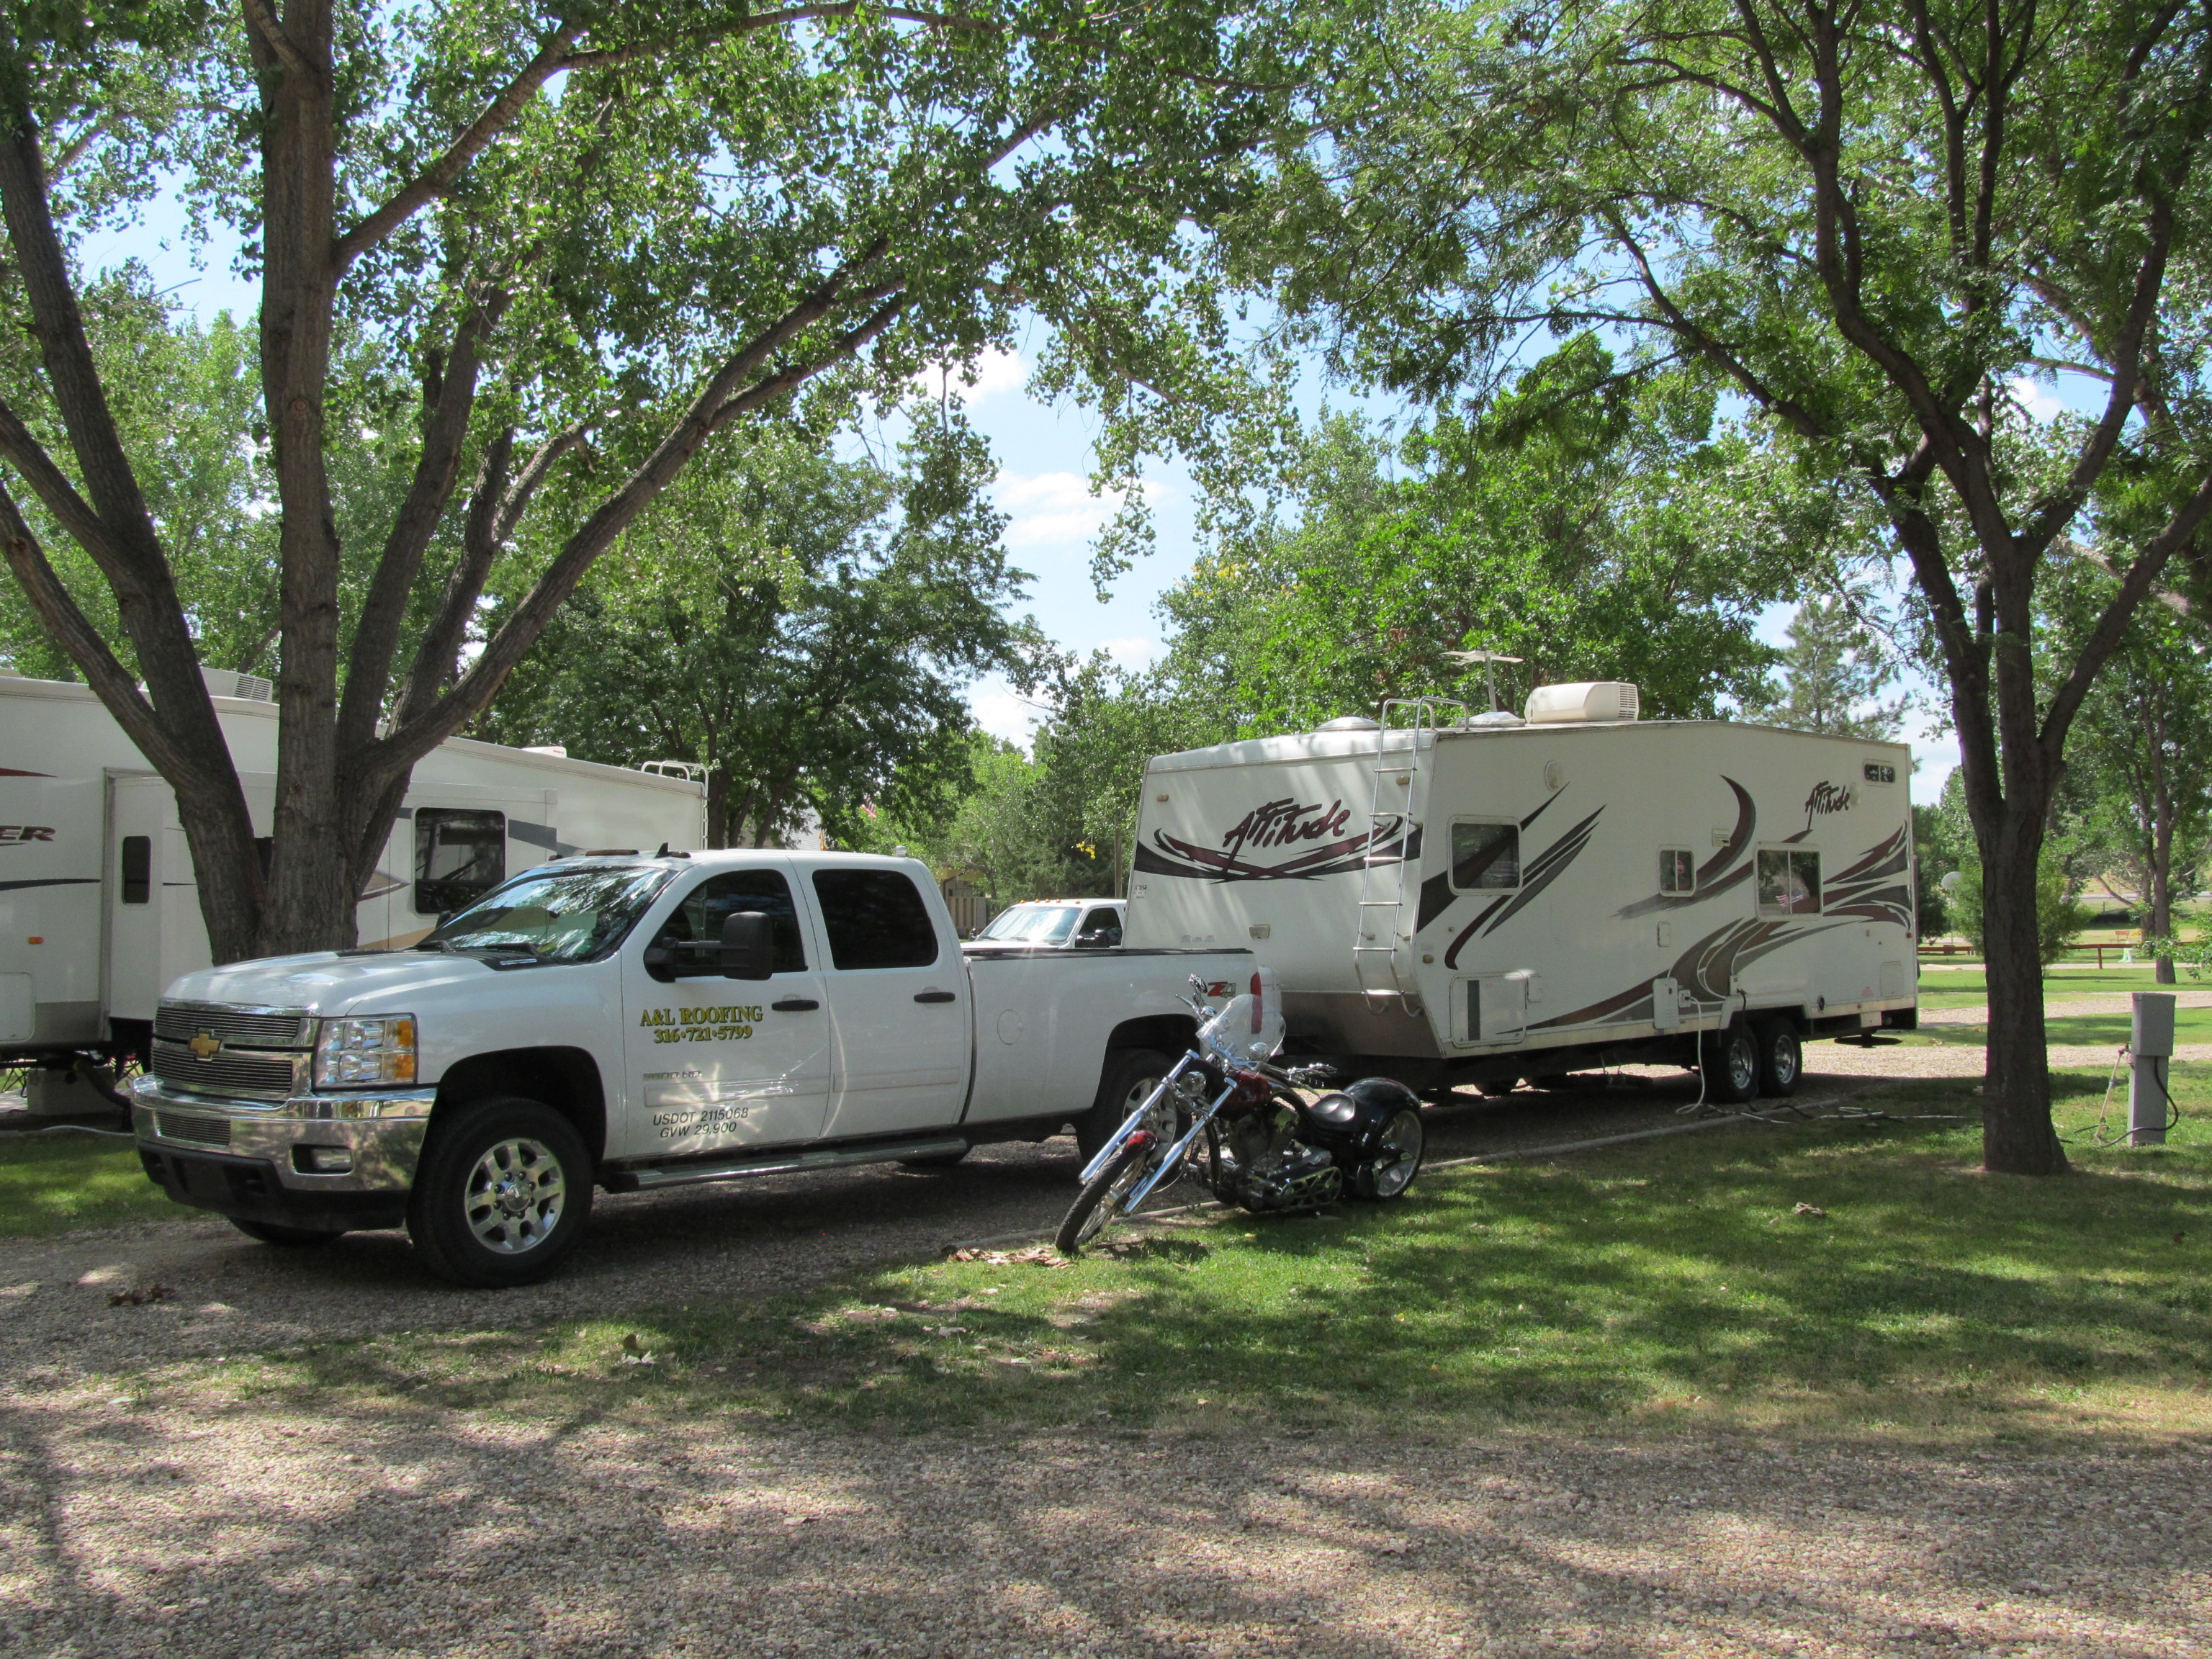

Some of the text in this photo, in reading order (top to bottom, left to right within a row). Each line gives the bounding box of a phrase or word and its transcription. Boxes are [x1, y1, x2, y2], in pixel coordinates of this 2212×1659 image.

[1208, 981, 1236, 997] Z71
[640, 1005, 763, 1027] A&L ROOFING
[653, 1107, 749, 1125] USDOT 2115068
[660, 1122, 737, 1138] GVW 29,900
